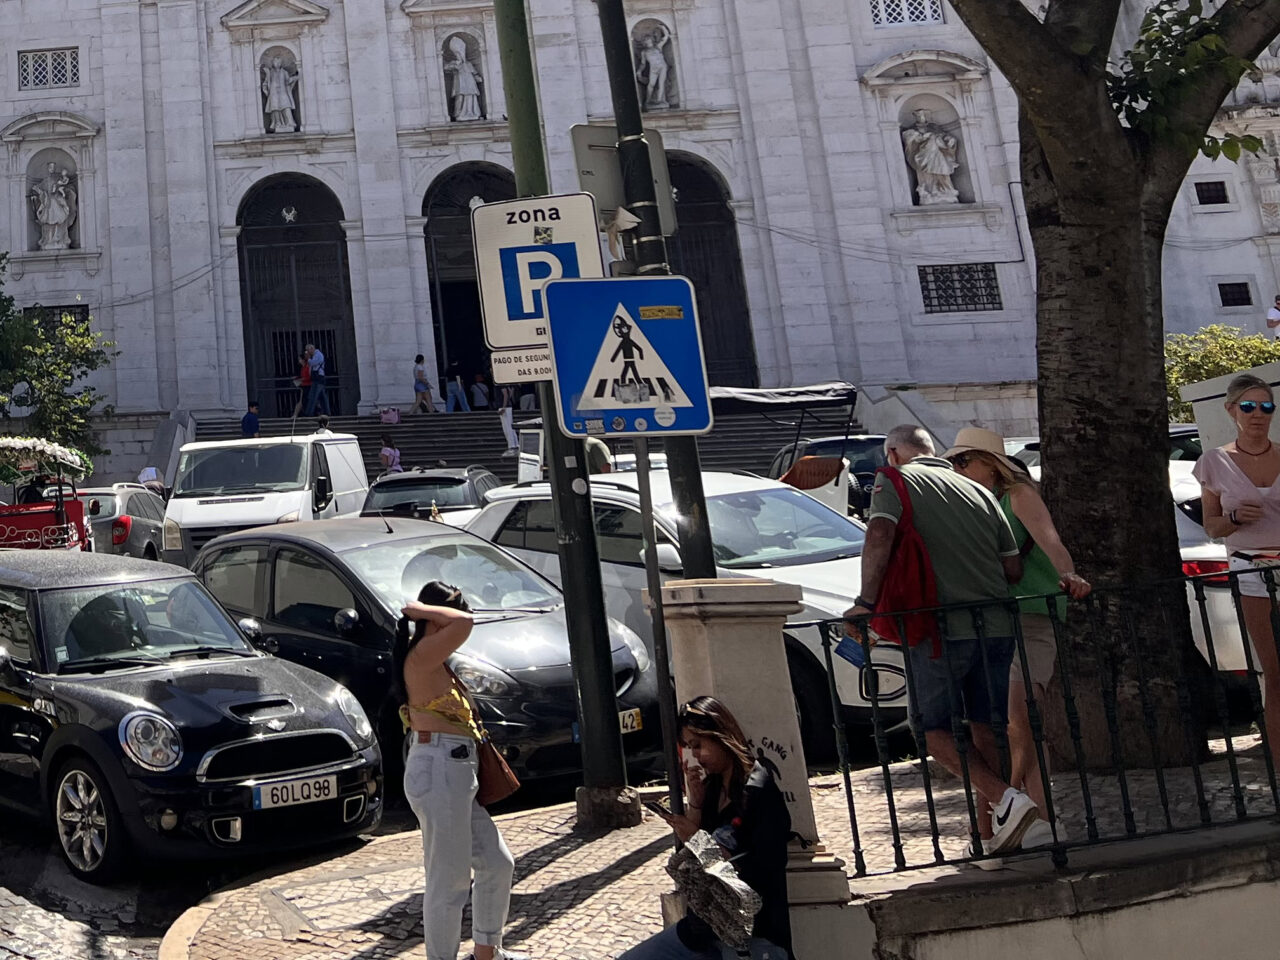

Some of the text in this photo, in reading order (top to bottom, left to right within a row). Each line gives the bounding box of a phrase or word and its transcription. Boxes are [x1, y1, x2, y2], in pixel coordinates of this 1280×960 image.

[506, 207, 561, 224] zona
[516, 251, 563, 313] P
[761, 736, 788, 760] GANG
